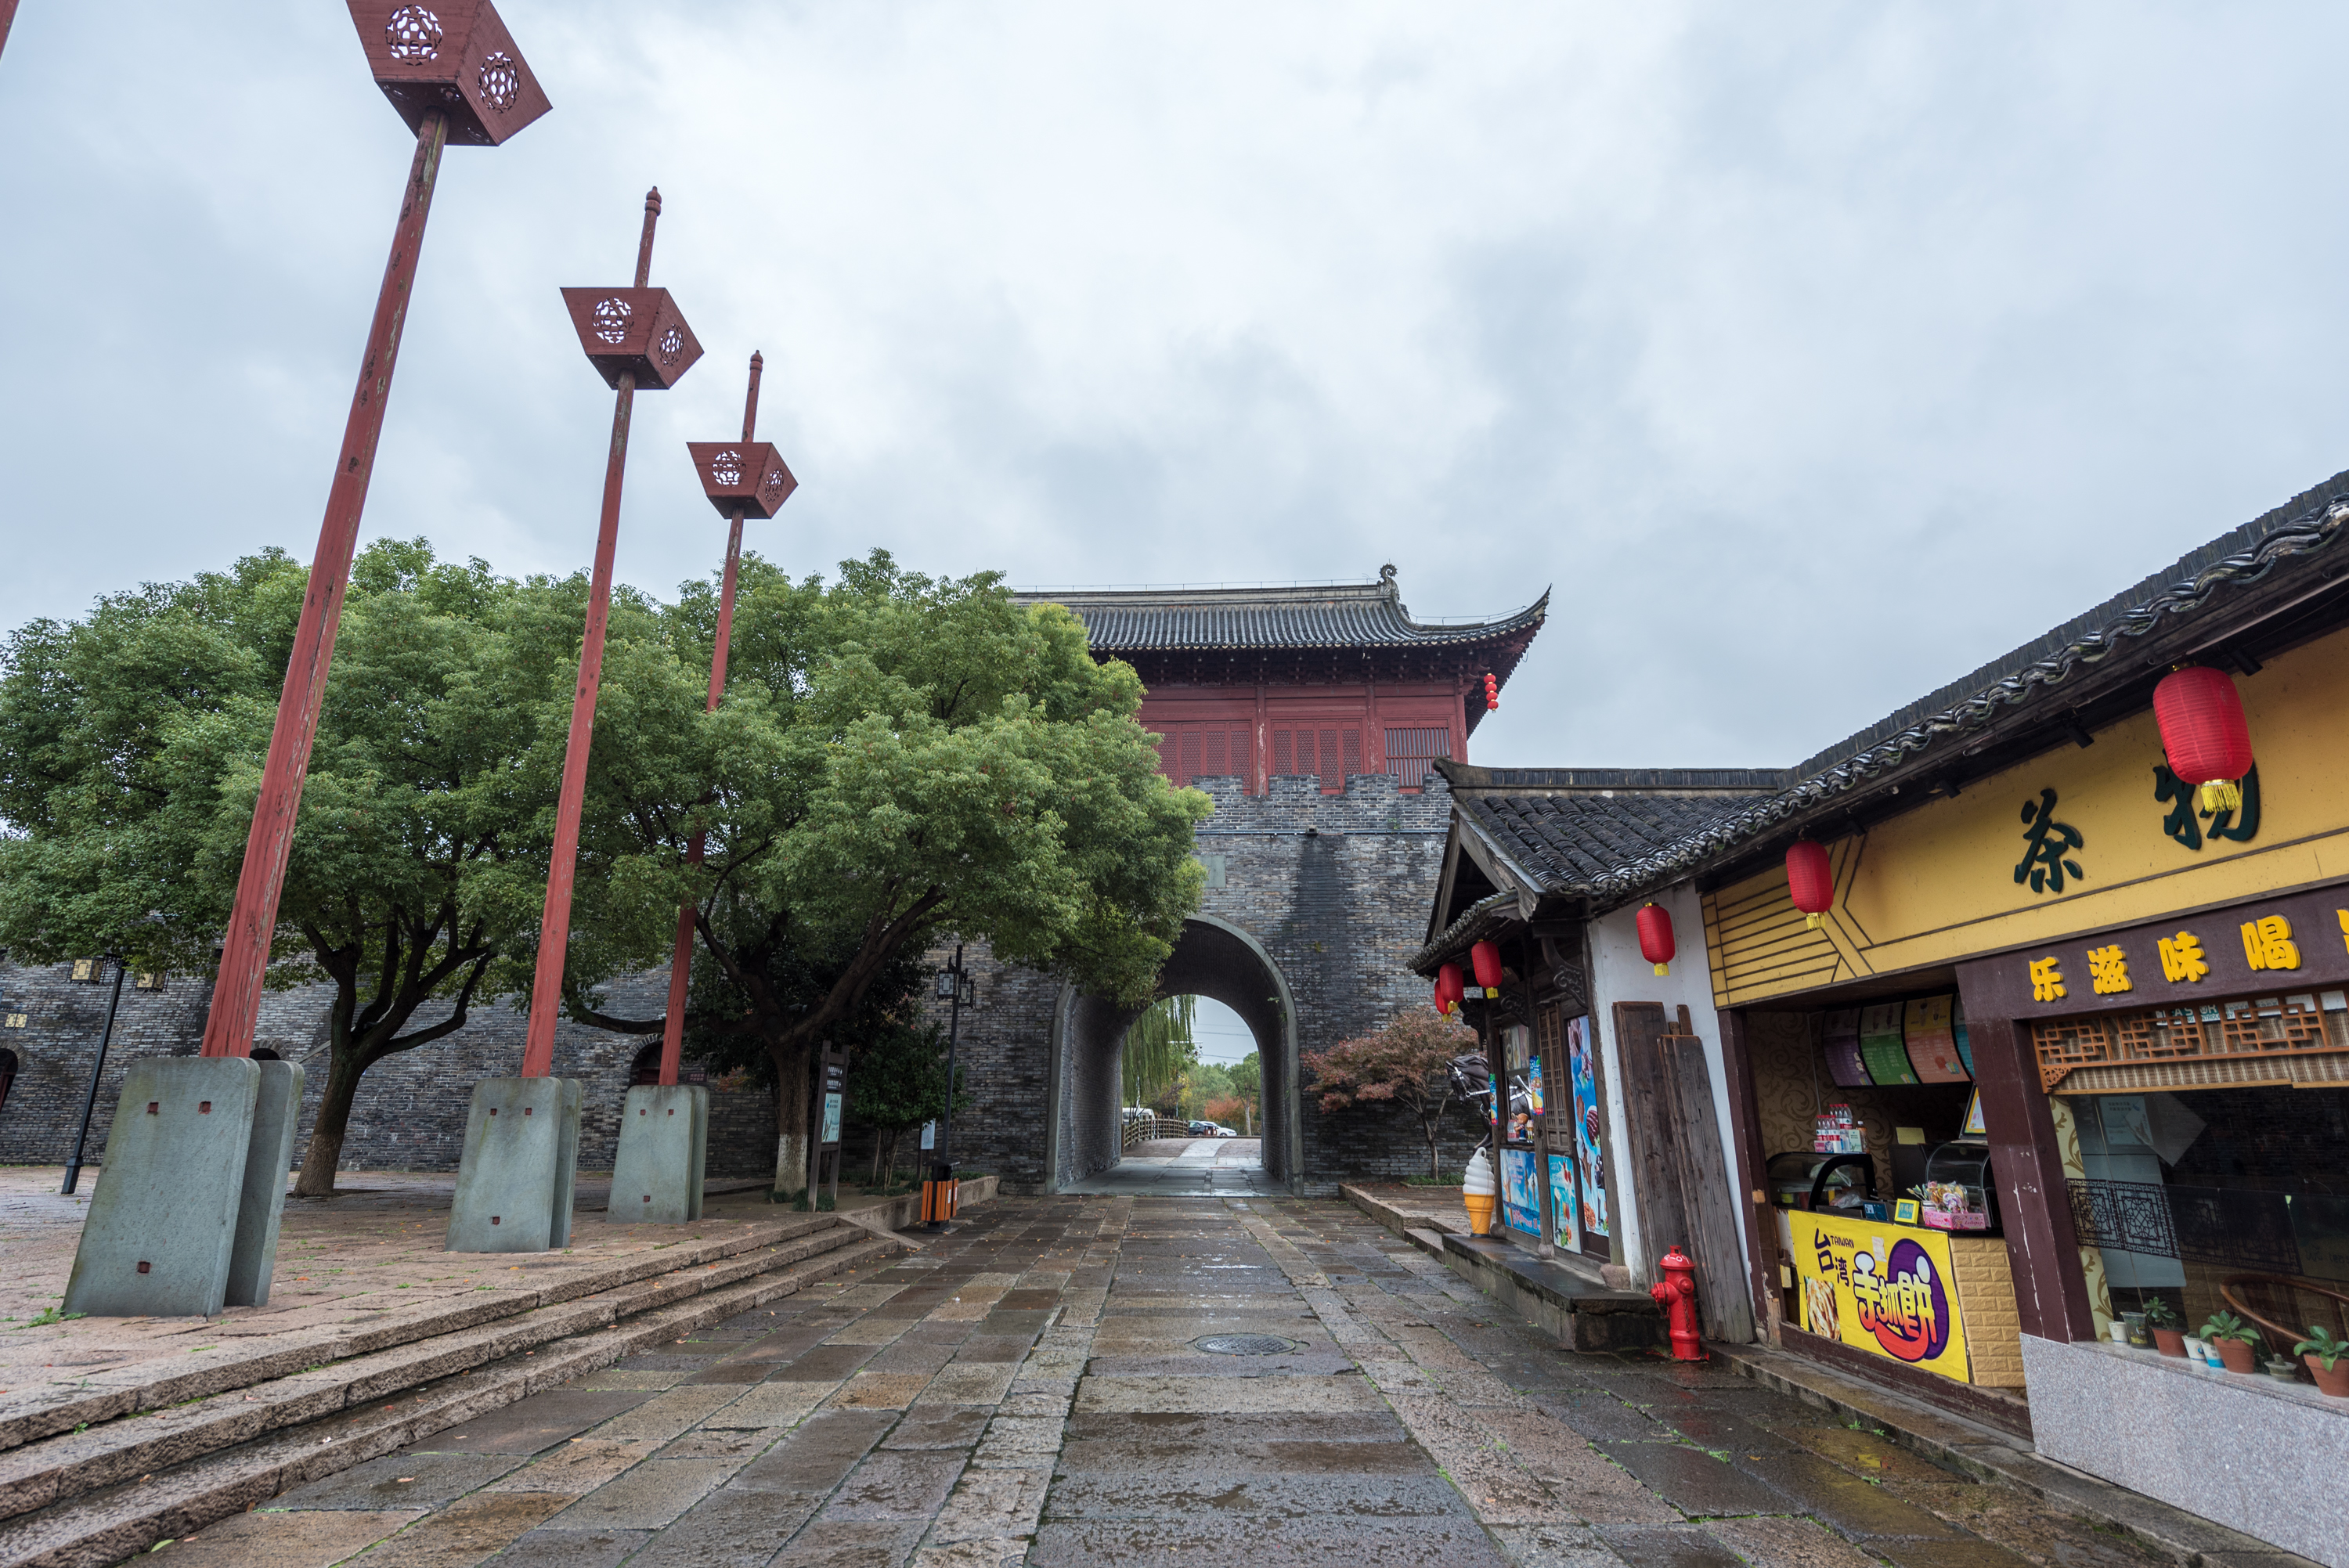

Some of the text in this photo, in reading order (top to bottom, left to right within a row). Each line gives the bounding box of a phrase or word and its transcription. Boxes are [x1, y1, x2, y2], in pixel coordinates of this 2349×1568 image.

[2029, 909, 2349, 1002] 乐滋味喝
[1814, 1227, 1850, 1288] 台湾
[1830, 1235, 1855, 1249] TAIWAN
